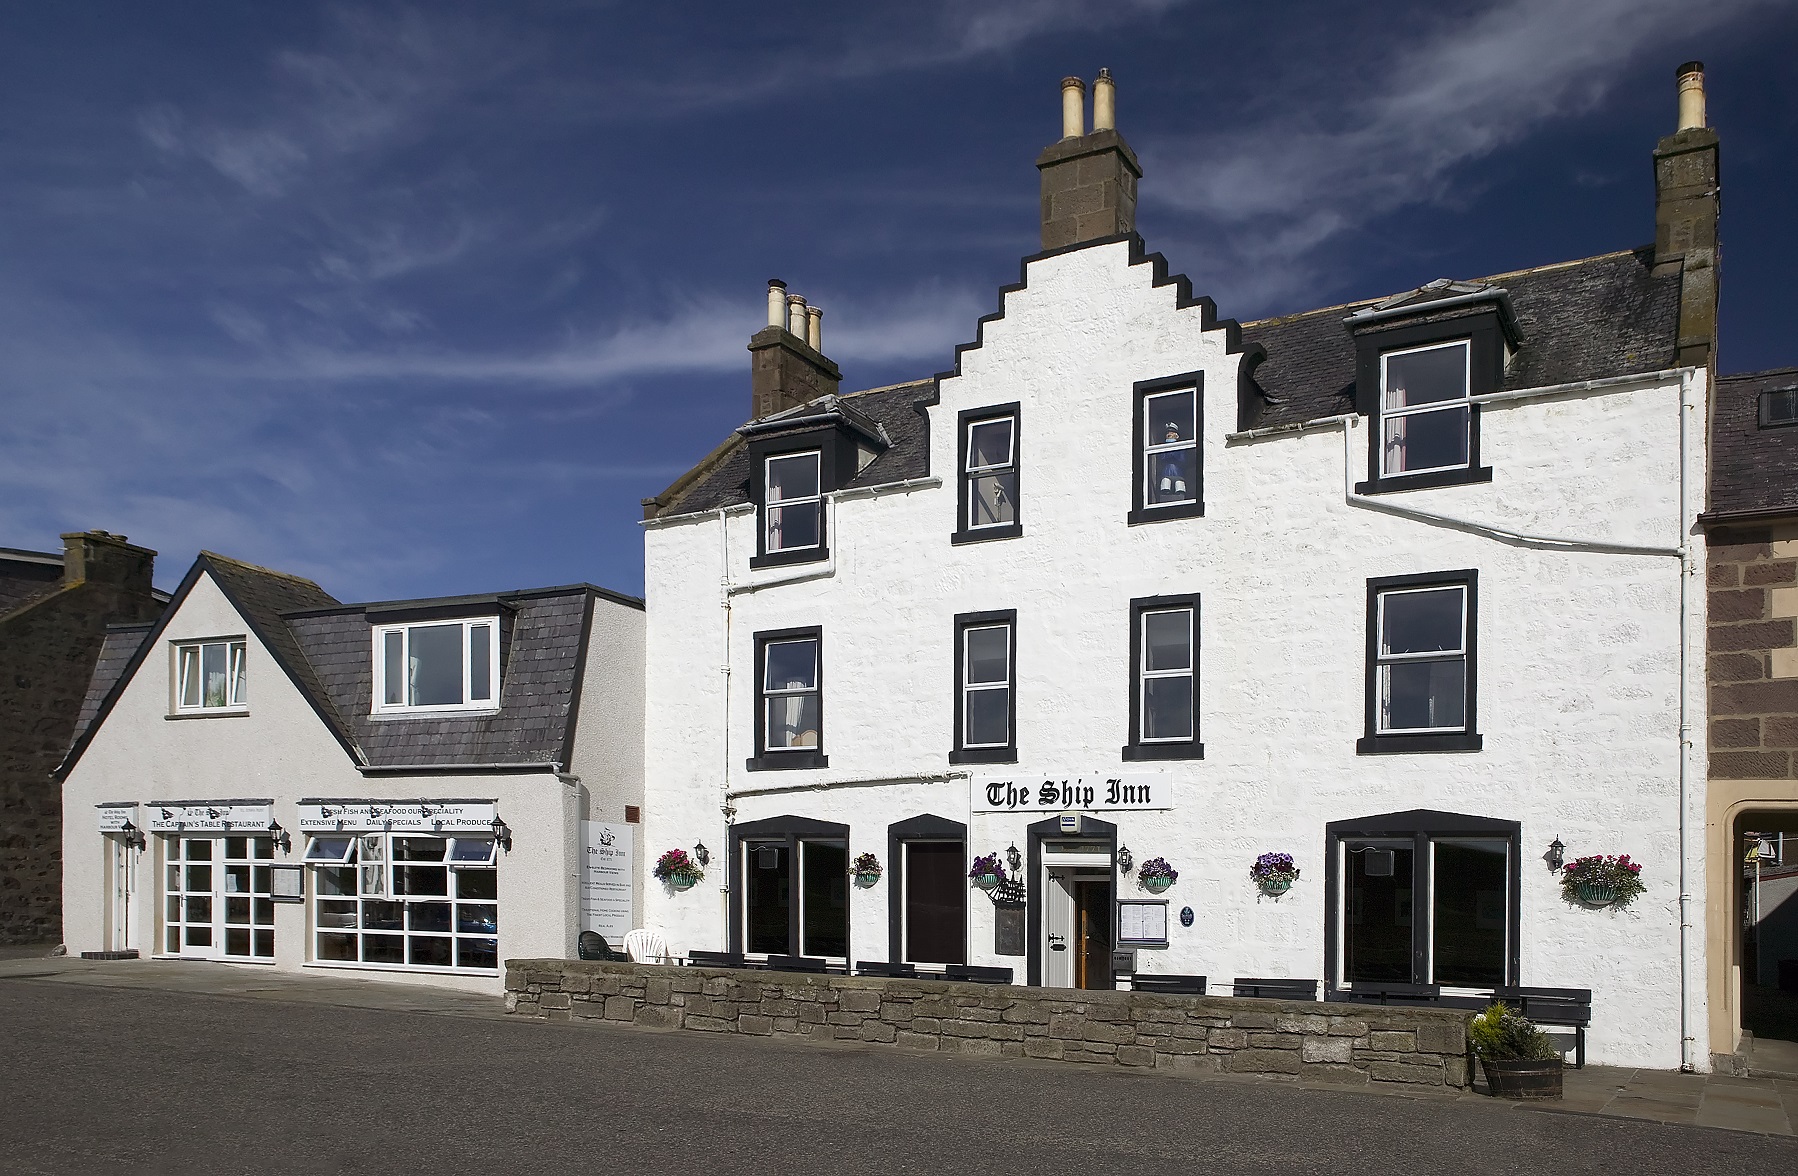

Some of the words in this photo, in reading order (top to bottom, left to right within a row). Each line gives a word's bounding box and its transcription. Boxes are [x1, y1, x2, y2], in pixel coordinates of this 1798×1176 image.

[985, 780, 1030, 810] The
[1038, 779, 1094, 809] Ship
[1104, 778, 1151, 805] Inn
[343, 807, 358, 815] FISH
[152, 820, 165, 828] THE
[165, 820, 199, 828] CAPTAIN'S
[200, 820, 221, 828] TABLE
[221, 820, 265, 828] RESTAURANT
[300, 818, 336, 826] EXTENSIVE
[337, 818, 358, 826] MENU
[366, 818, 387, 826] DAILY
[387, 818, 422, 826] SPECIALS
[431, 818, 455, 826] LOCAL
[456, 818, 492, 826] PRODUCE
[586, 846, 598, 856] The
[600, 847, 613, 856] Ship
